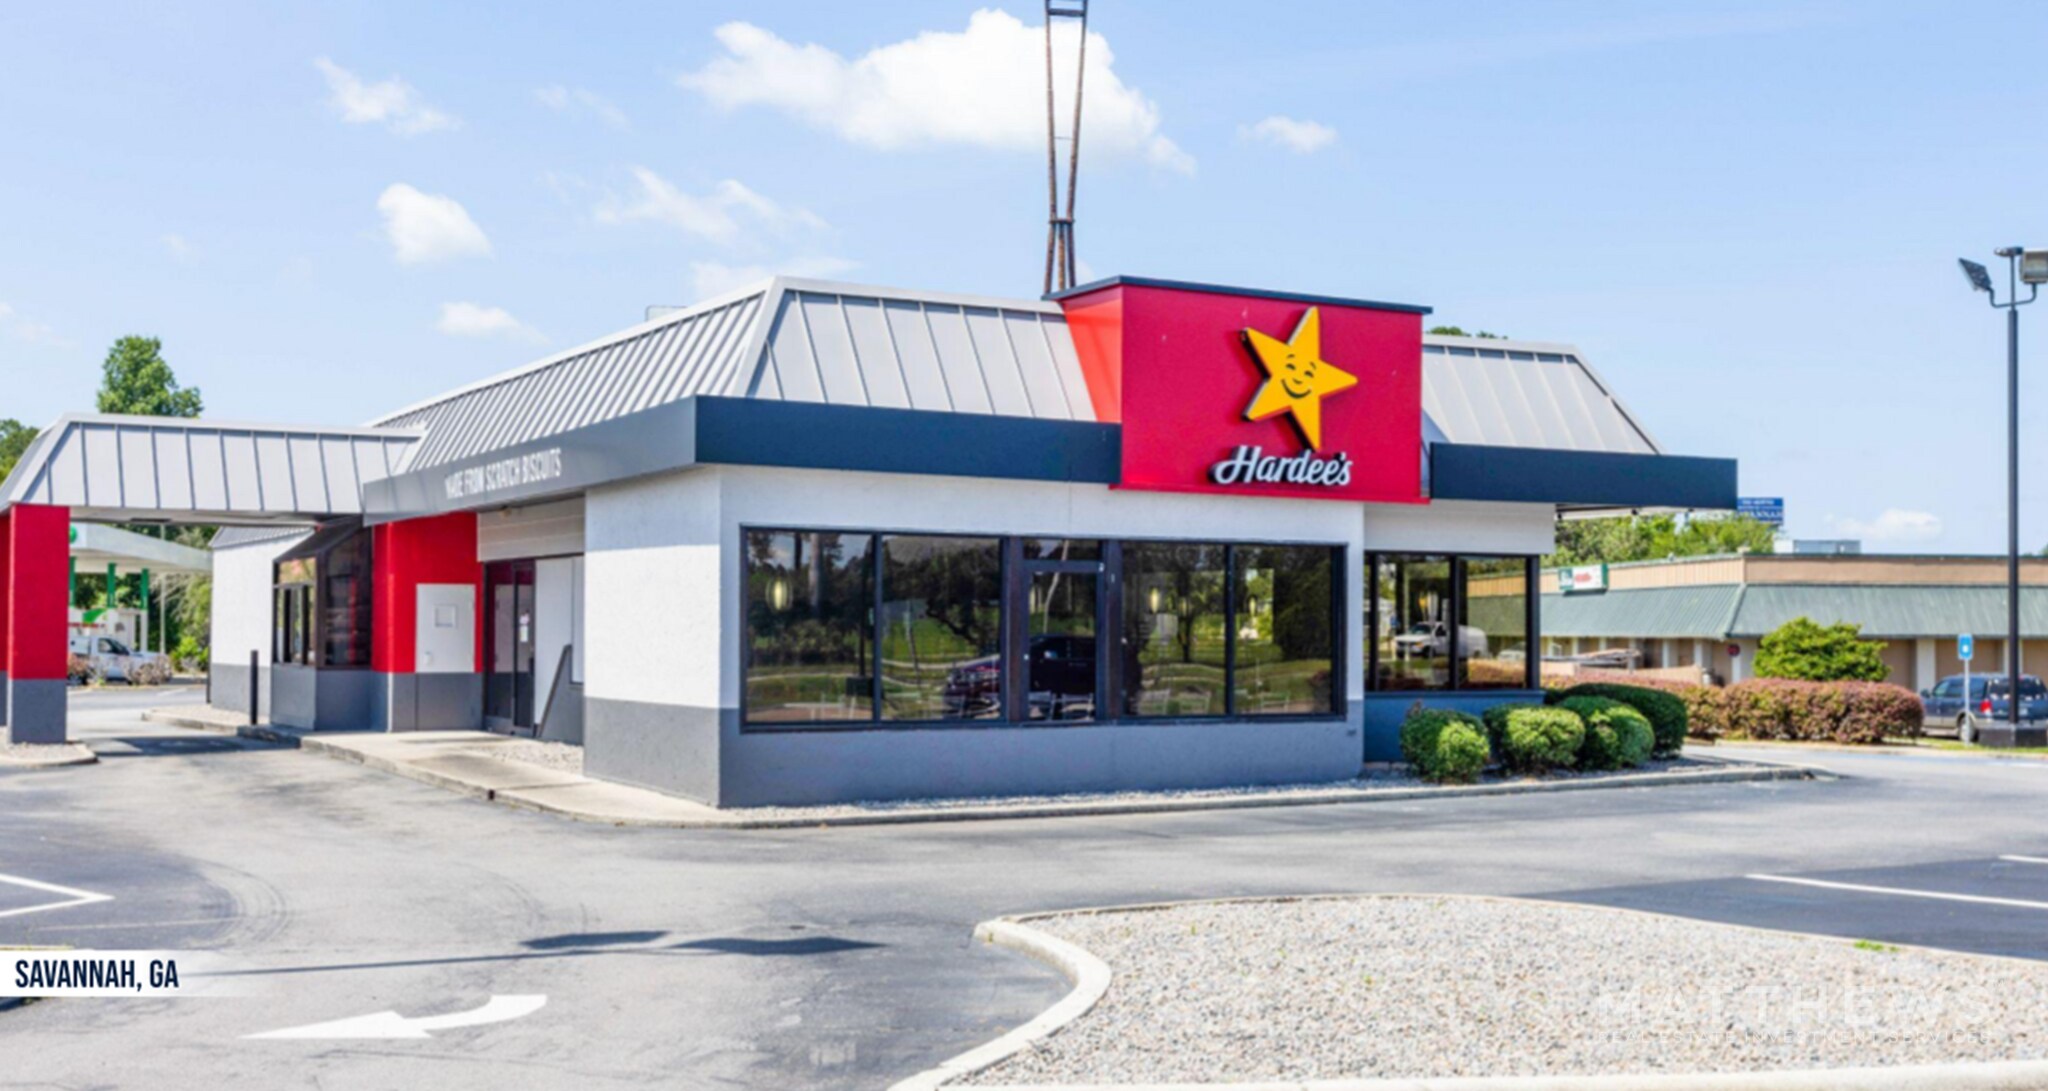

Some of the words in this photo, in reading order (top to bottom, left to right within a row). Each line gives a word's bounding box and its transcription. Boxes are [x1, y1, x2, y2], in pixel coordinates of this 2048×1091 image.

[464, 466, 484, 494] FROM
[485, 457, 520, 491] SCRATCH
[522, 448, 561, 483] BISCUITS
[1214, 445, 1353, 486] Hardee's
